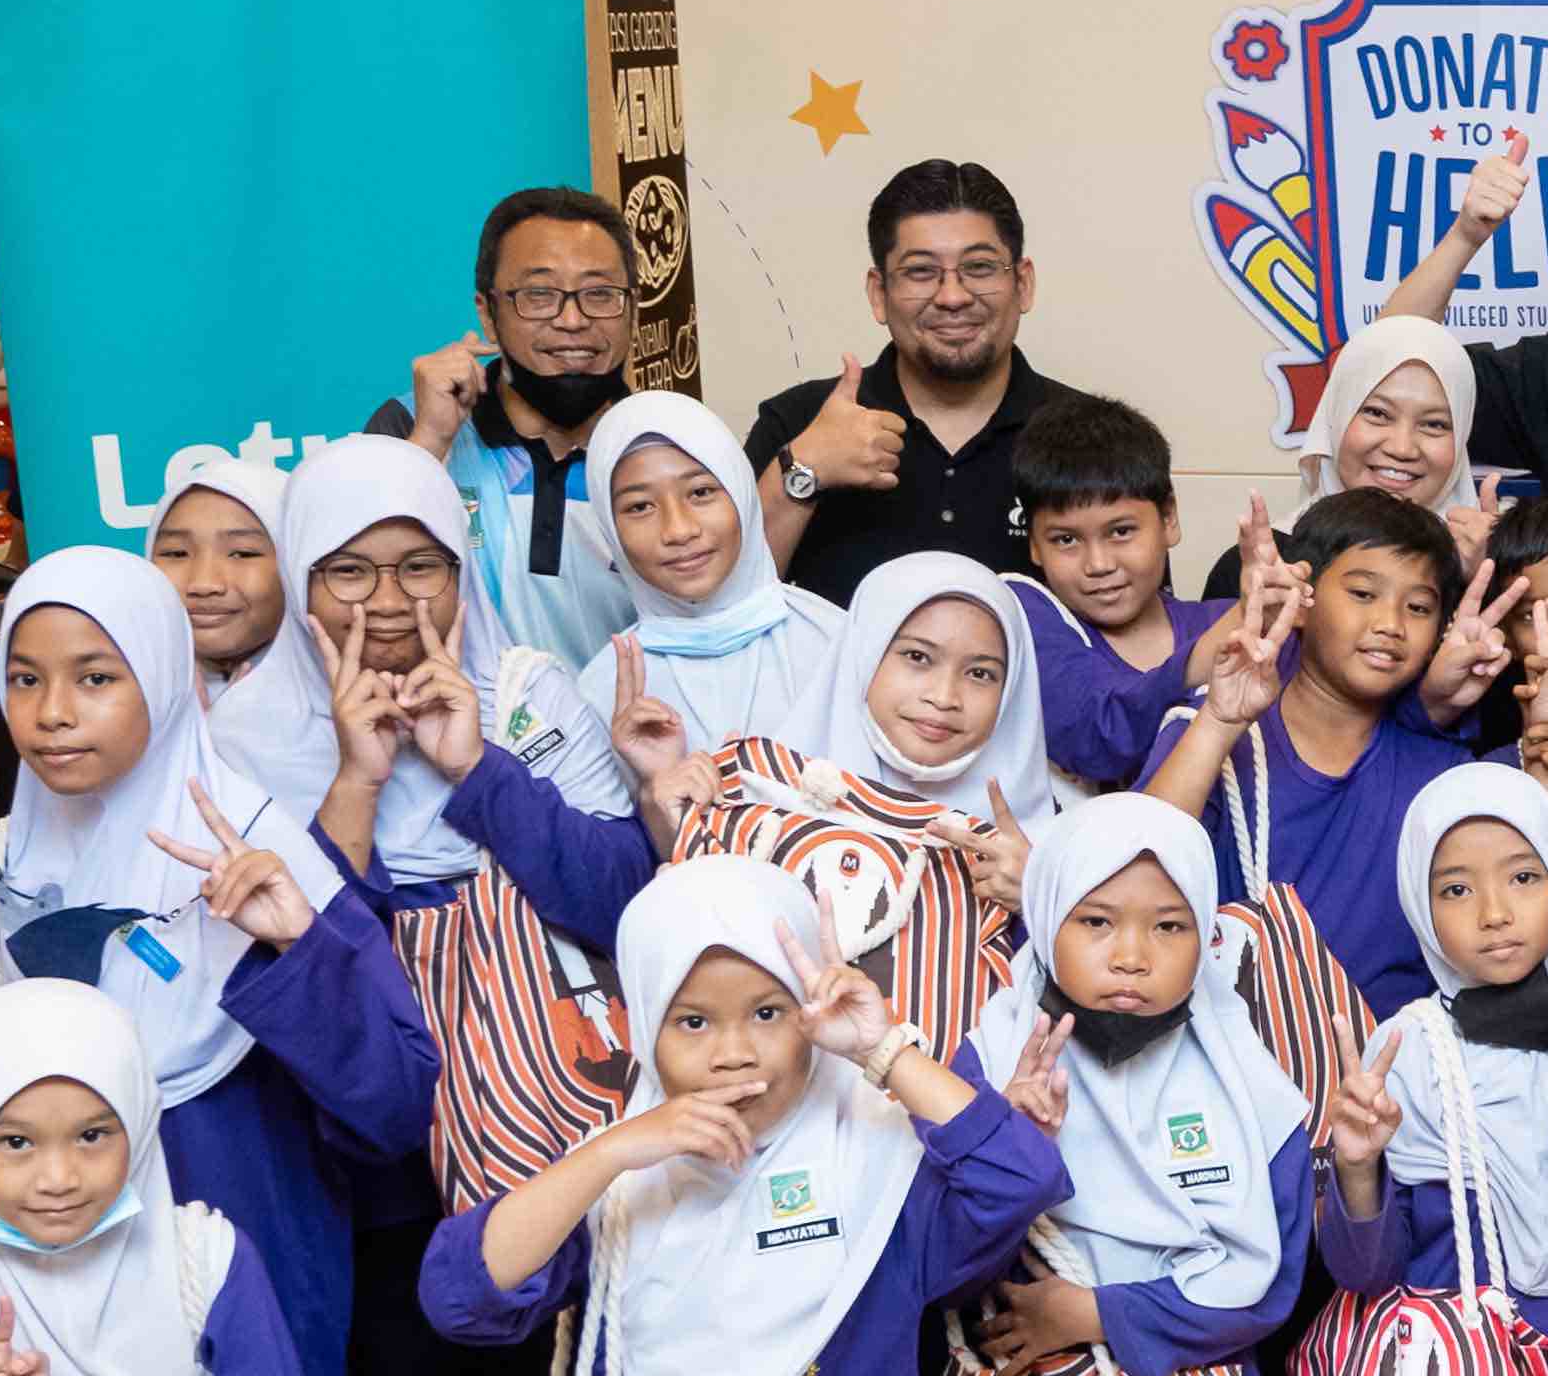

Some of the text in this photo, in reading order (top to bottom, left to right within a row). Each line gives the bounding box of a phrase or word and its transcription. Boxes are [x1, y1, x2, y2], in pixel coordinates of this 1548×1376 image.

[609, 12, 629, 51] ASI
[613, 65, 685, 163] MENU
[1458, 122, 1492, 146] TO
